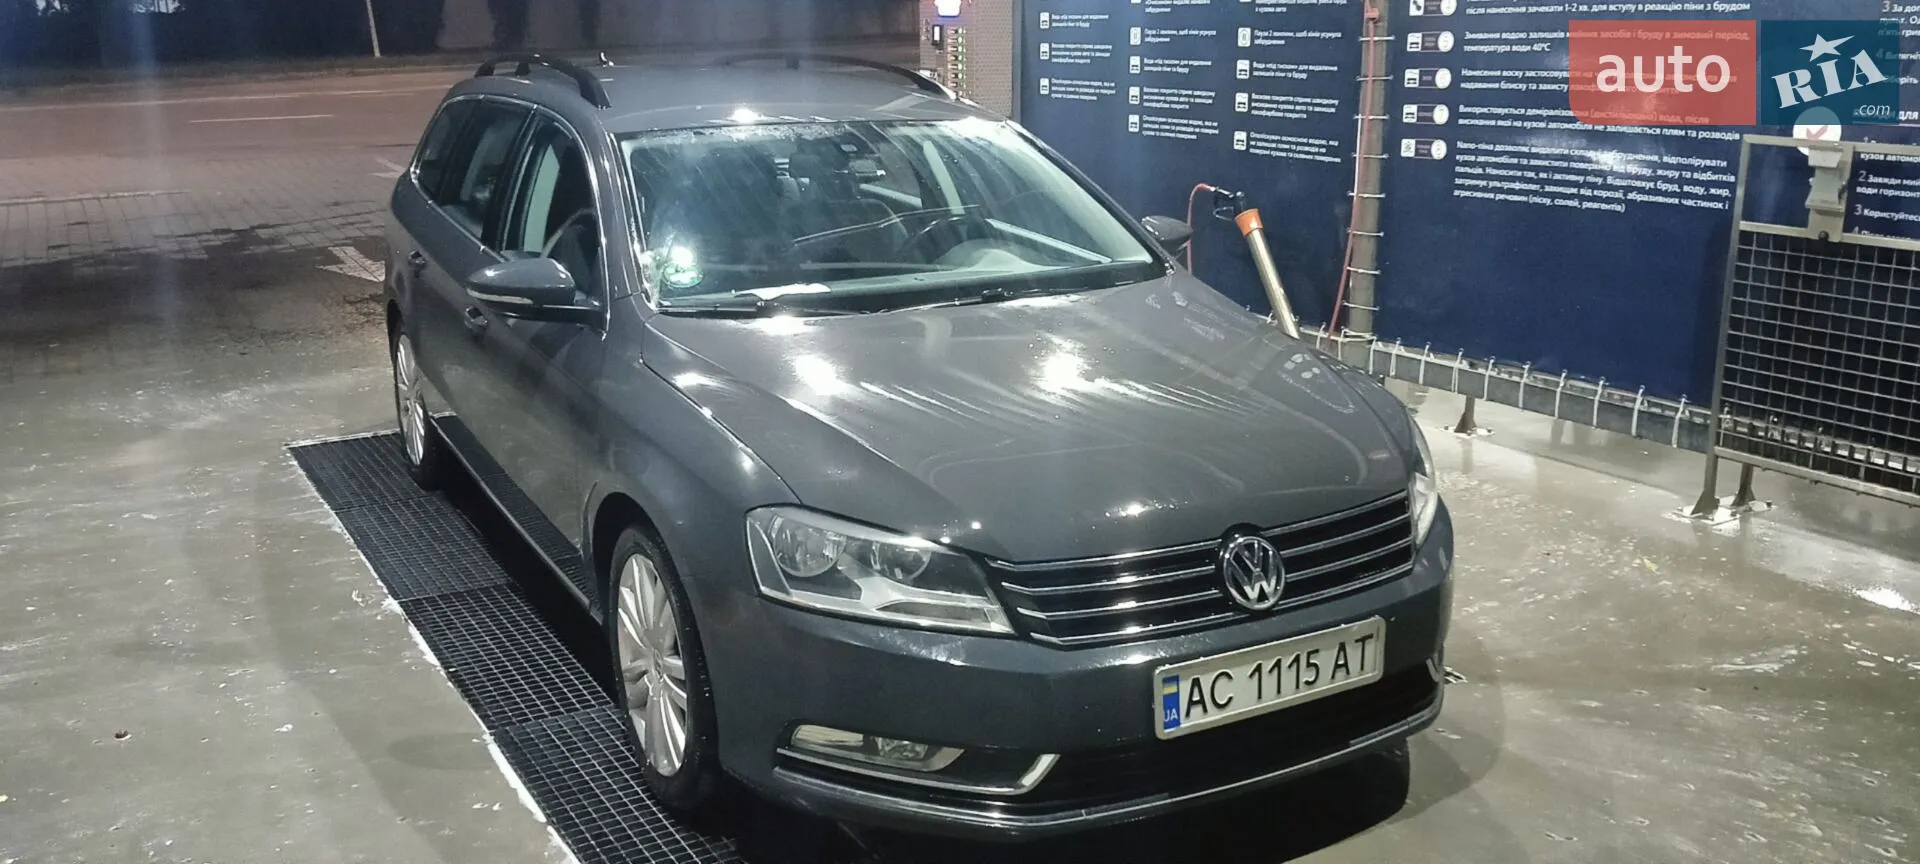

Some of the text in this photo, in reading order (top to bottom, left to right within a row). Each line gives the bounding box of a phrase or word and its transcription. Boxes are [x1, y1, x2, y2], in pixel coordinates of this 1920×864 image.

[1185, 634, 1374, 718] AC 1115 AT
[1164, 709, 1178, 722] UA
